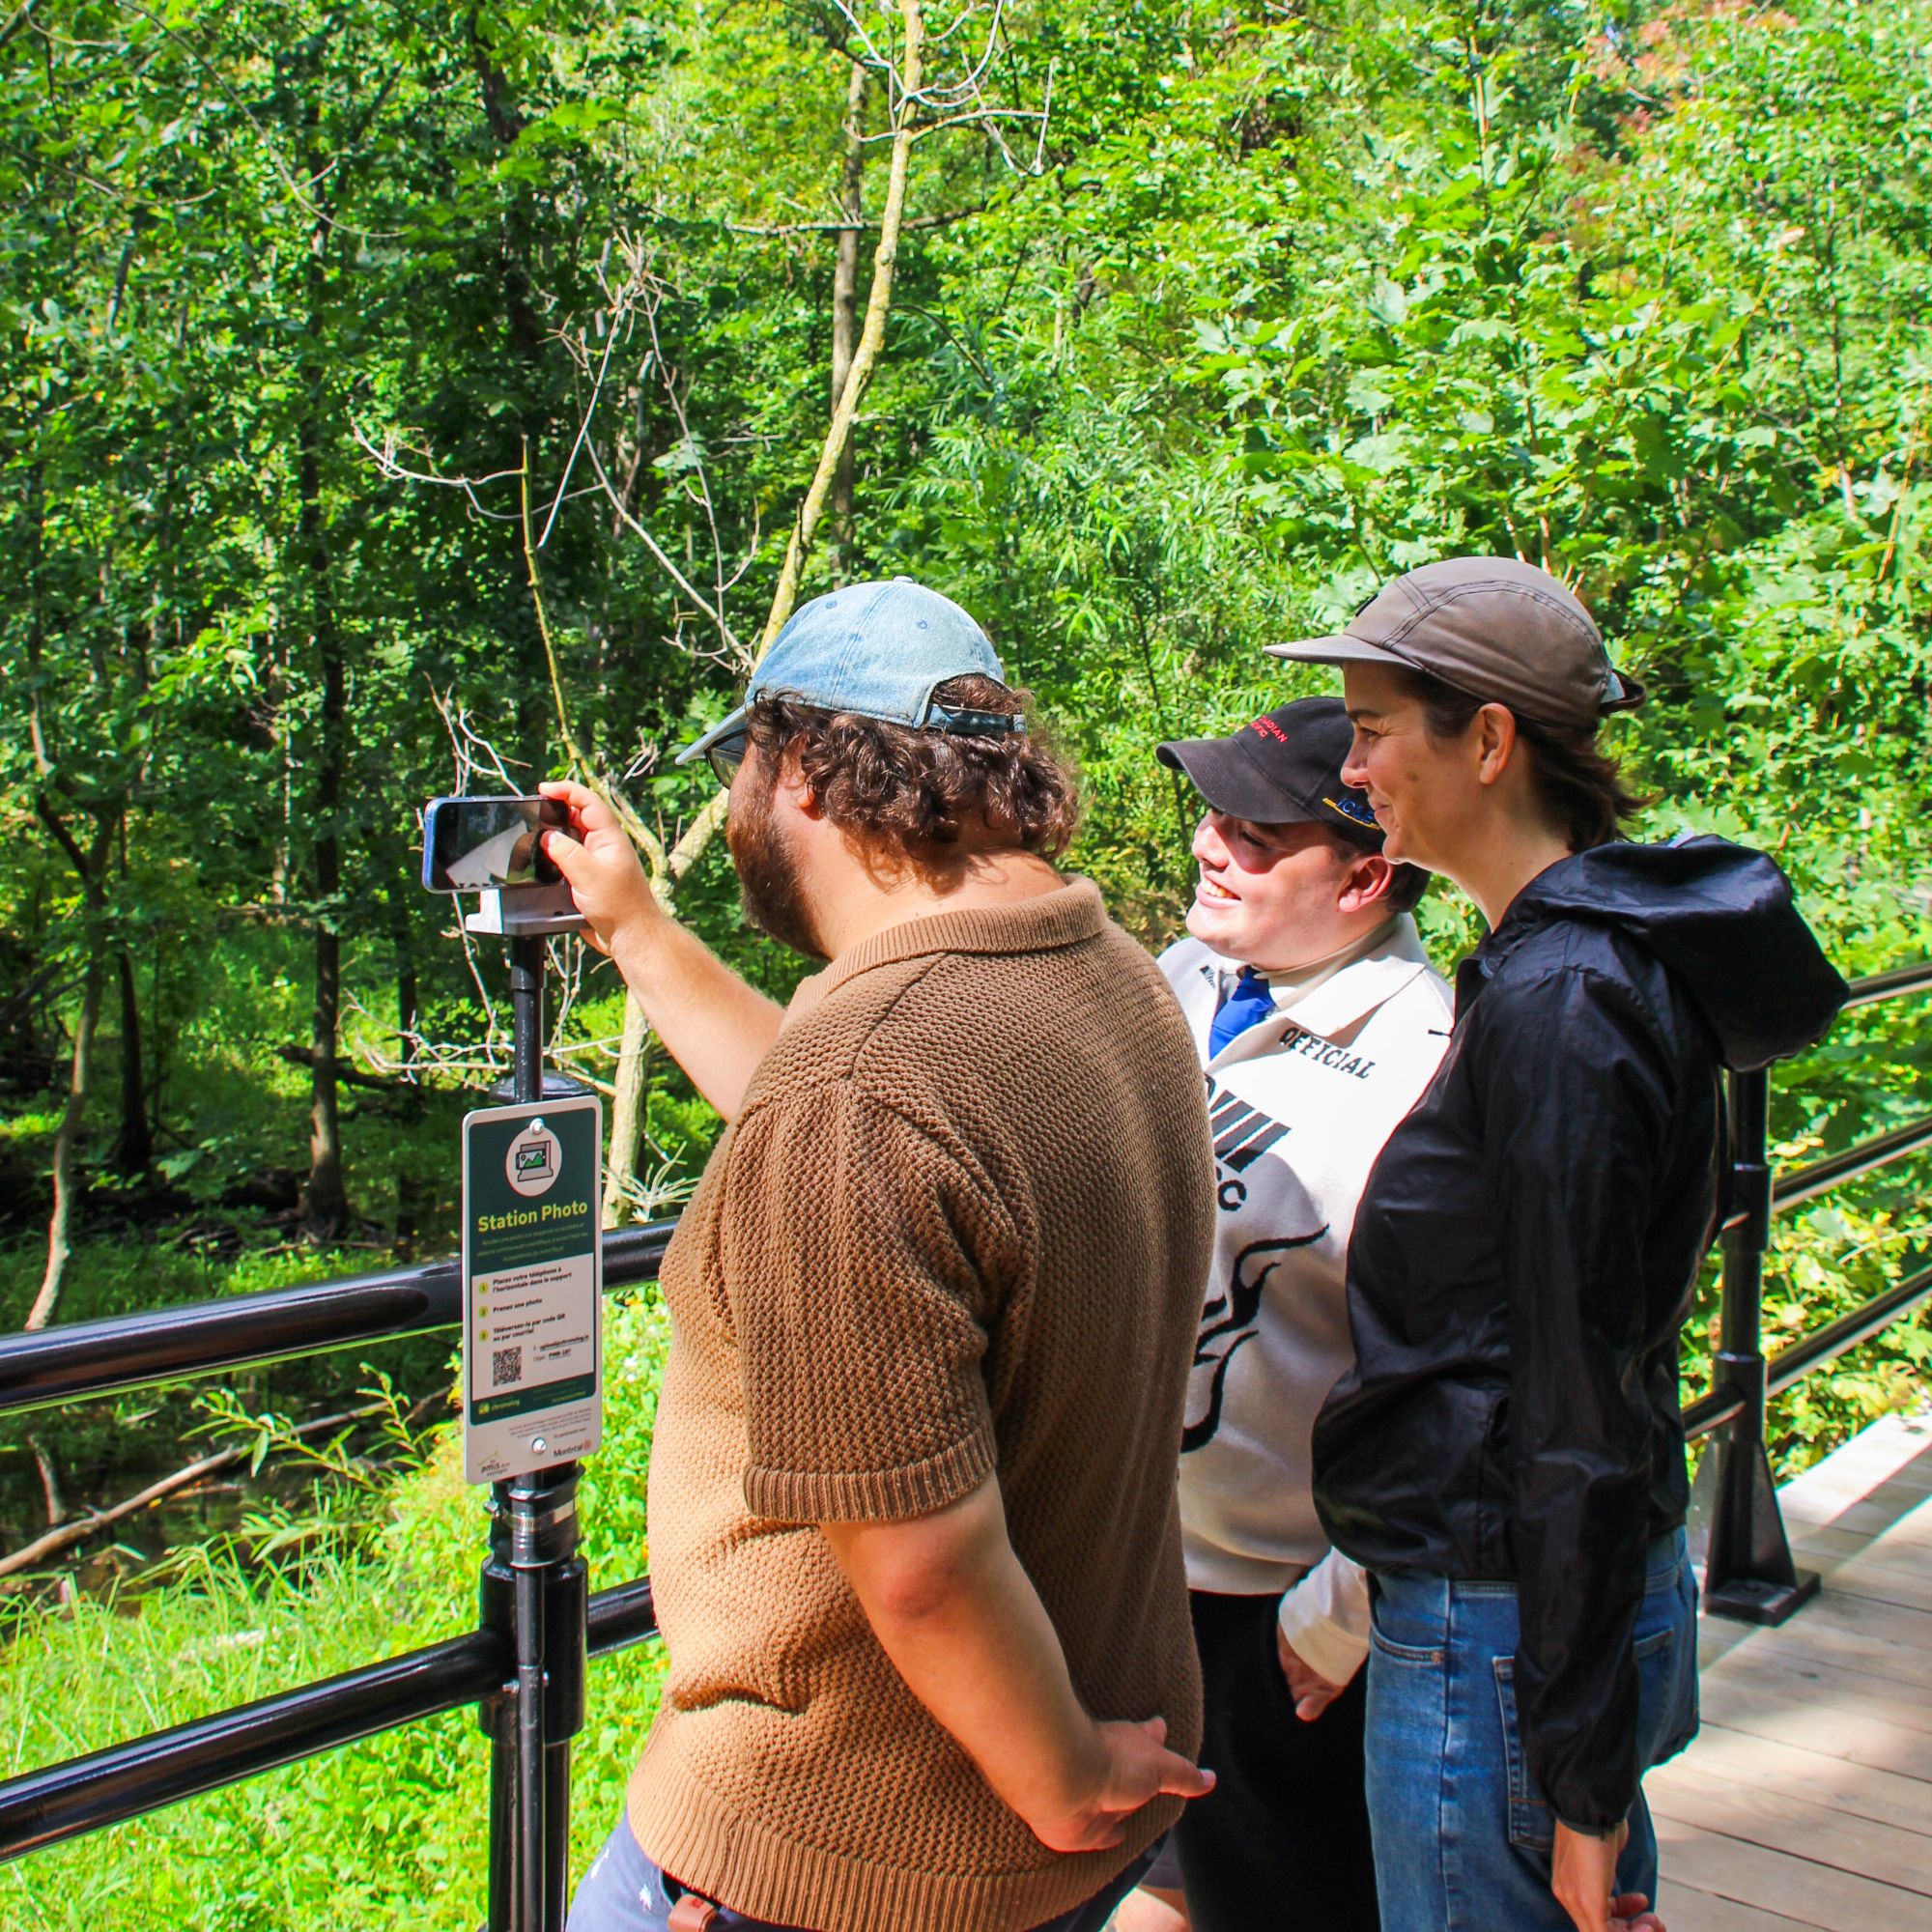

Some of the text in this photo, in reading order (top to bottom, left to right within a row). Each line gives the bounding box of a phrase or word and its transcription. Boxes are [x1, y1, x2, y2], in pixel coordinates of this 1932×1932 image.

[1279, 1027, 1376, 1079] OFFICIAL
[477, 1200, 588, 1233] Station Photo
[526, 1298, 543, 1307] photo
[554, 1443, 583, 1457] Montréal
